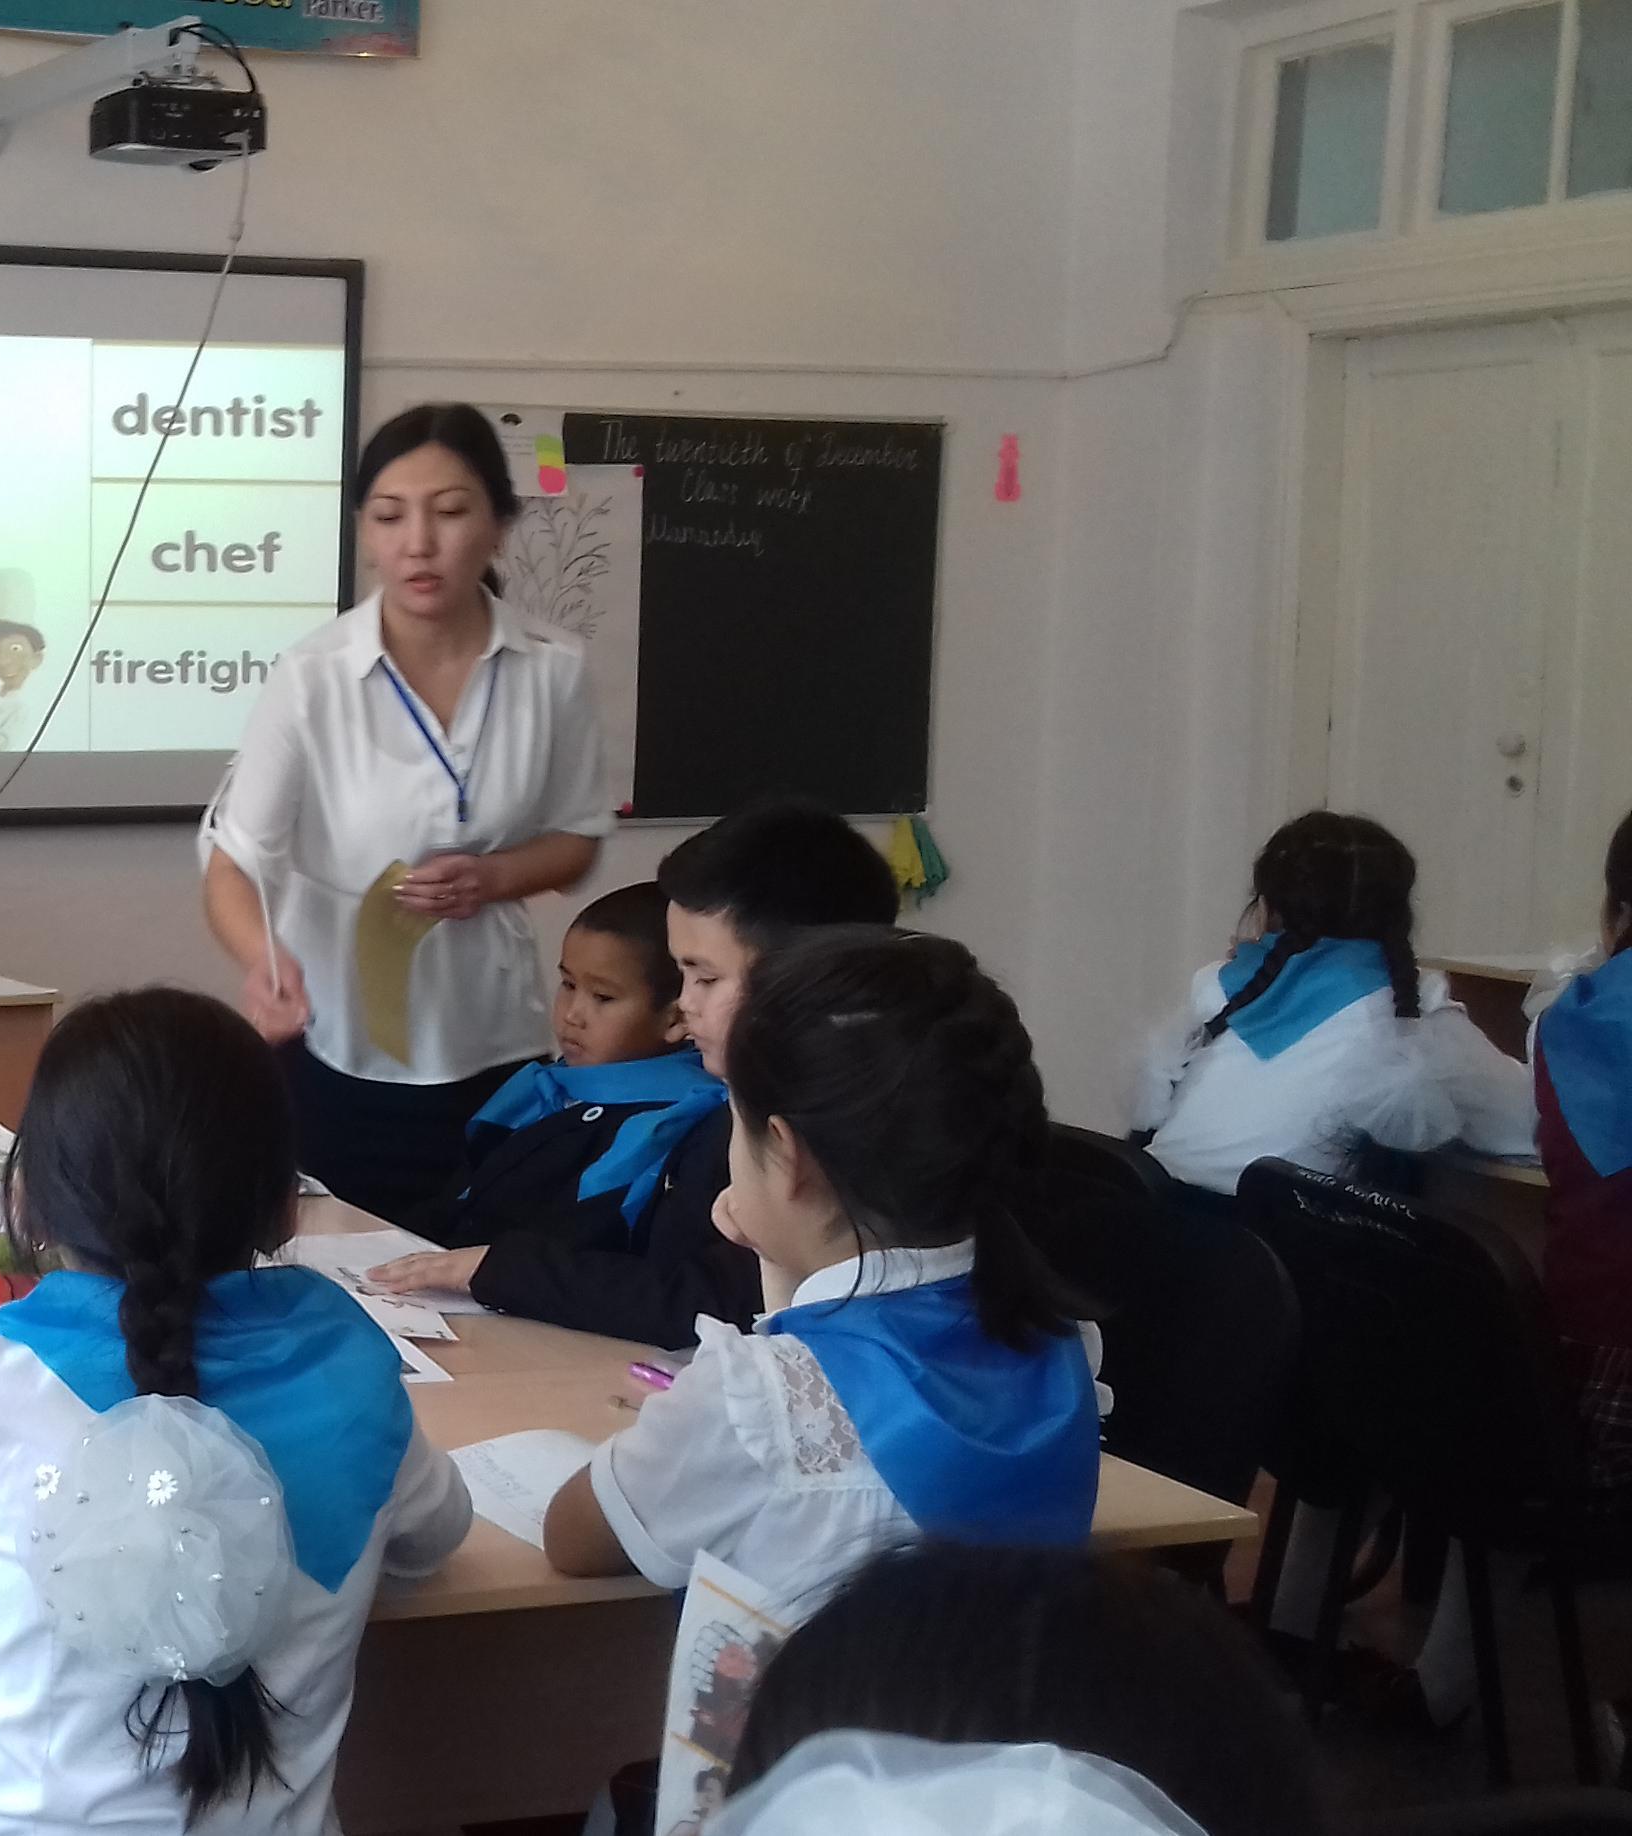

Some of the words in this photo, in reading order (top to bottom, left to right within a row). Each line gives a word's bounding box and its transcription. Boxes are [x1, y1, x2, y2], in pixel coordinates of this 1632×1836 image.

[111, 392, 322, 438] dentist
[600, 420, 638, 461] The
[151, 530, 281, 574] chef
